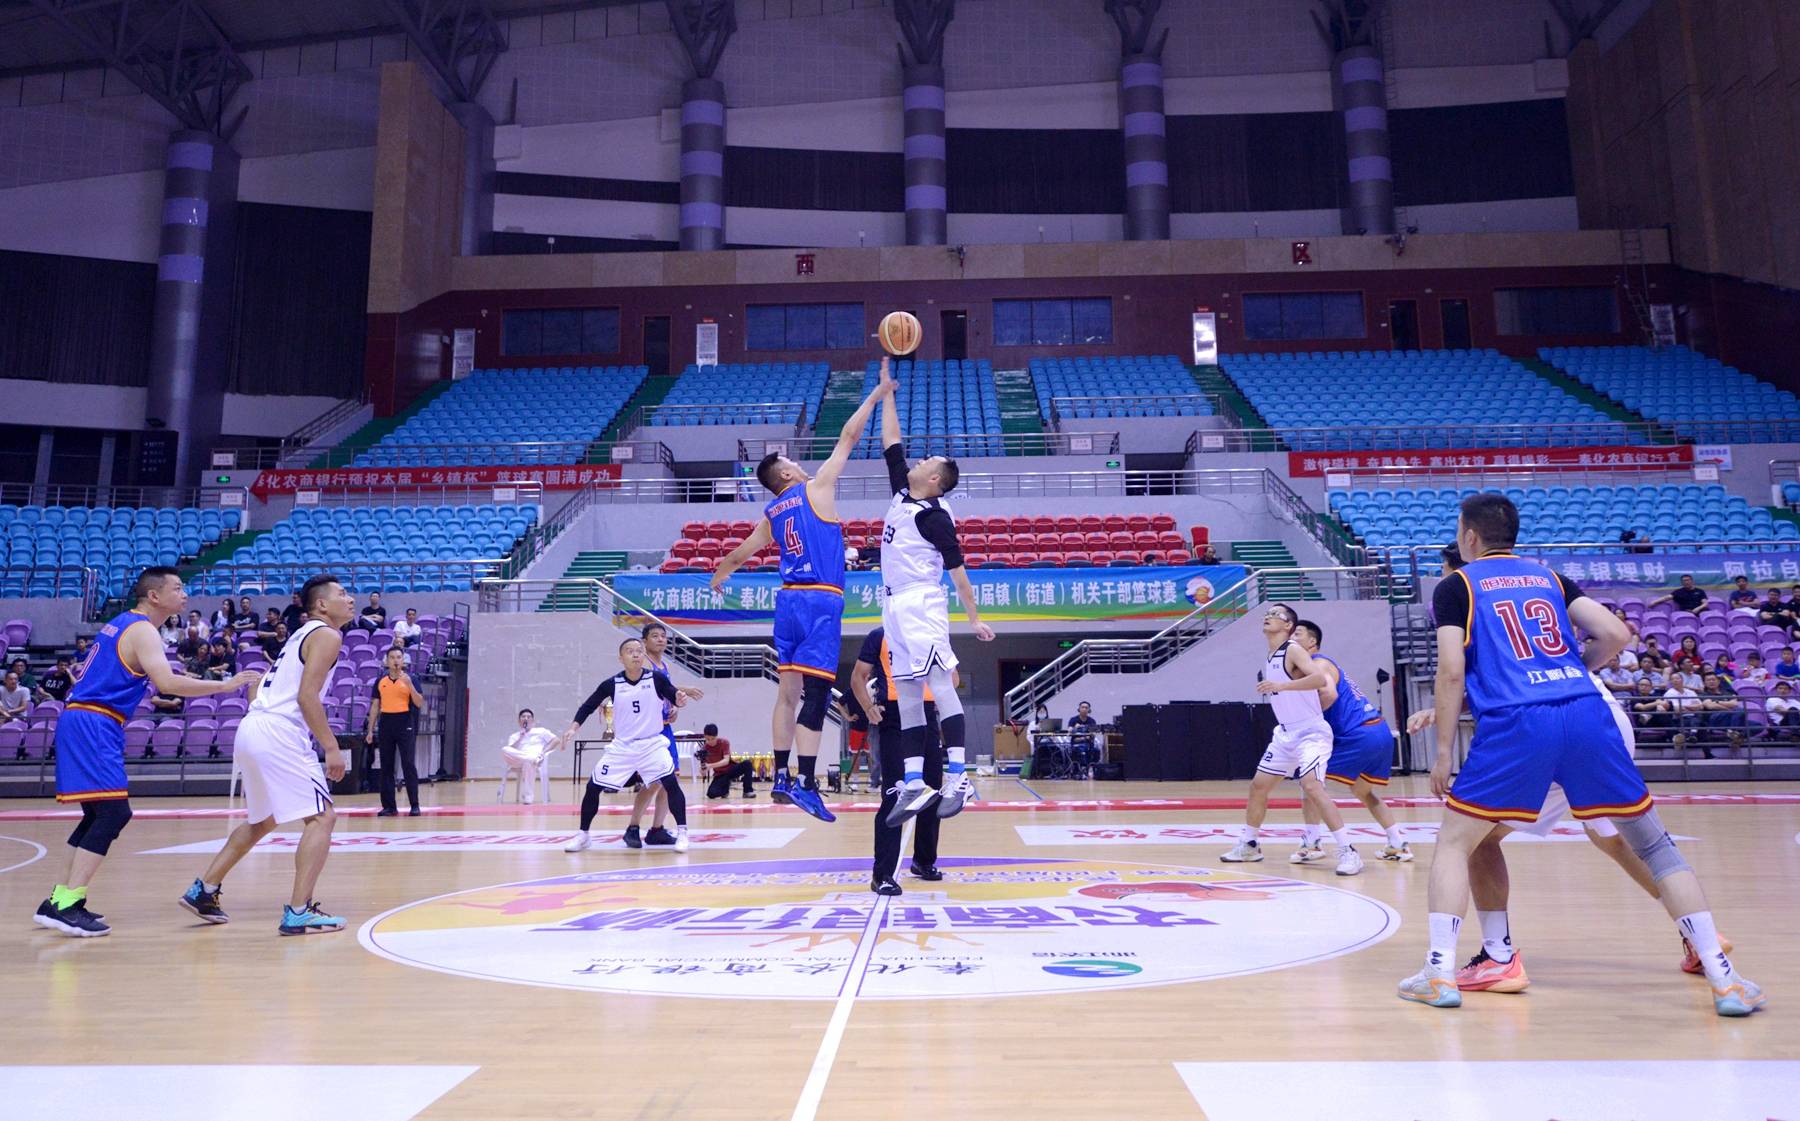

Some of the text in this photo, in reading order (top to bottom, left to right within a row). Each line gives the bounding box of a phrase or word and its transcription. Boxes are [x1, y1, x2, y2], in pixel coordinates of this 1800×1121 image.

[1292, 242, 1312, 264] 区
[784, 517, 804, 558] 4
[643, 586, 732, 611] “农商银行杯”
[1493, 598, 1570, 661] 13
[632, 700, 641, 714] 5
[601, 764, 609, 776] 5
[534, 905, 1221, 931] 农商银行杯
